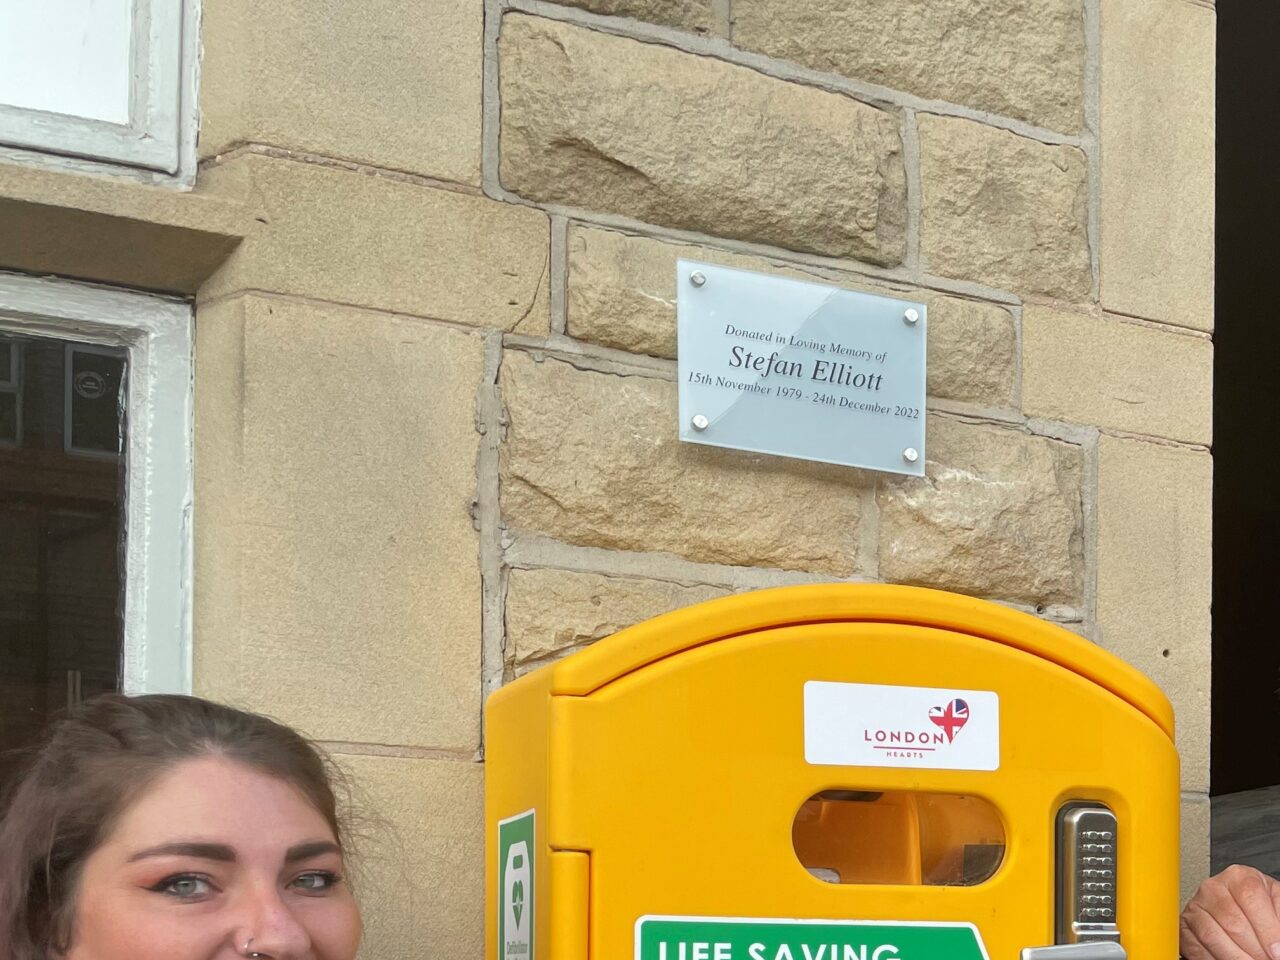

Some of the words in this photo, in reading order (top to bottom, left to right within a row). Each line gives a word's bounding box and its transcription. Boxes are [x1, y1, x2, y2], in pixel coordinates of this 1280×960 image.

[725, 324, 773, 342] Donated
[775, 333, 786, 344] in
[789, 335, 826, 353] Loving
[829, 342, 873, 361] Memory
[875, 352, 888, 364] of
[728, 345, 803, 378] Stefan
[811, 359, 883, 391] Elliott
[688, 371, 712, 385] 15th
[715, 376, 772, 395] November
[776, 386, 803, 400] 1979
[812, 392, 836, 406] 24th
[839, 396, 891, 415] December
[894, 405, 919, 419] 2022
[864, 729, 944, 744] LONDON
[886, 751, 923, 759] HEARTS
